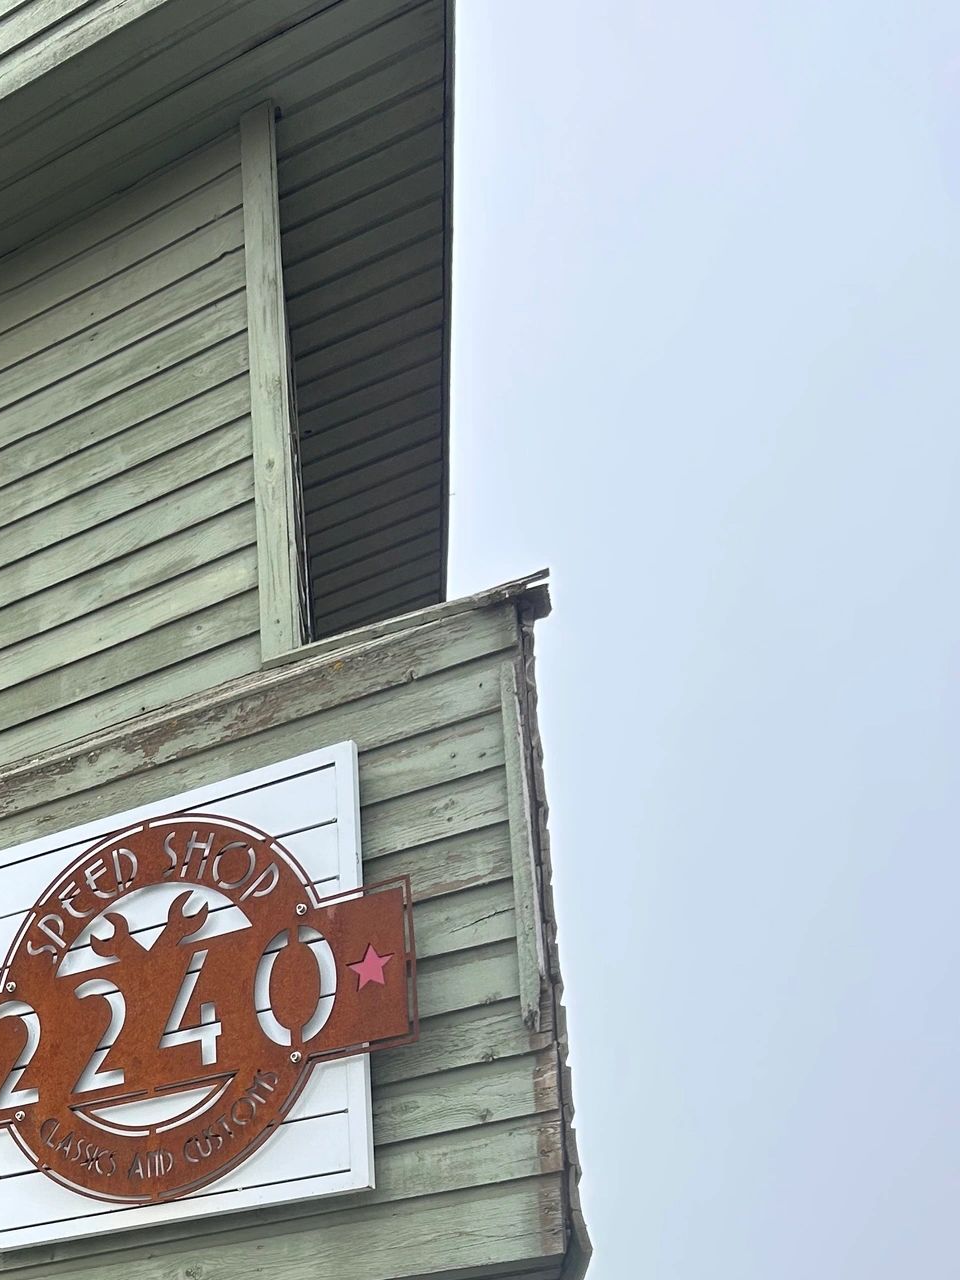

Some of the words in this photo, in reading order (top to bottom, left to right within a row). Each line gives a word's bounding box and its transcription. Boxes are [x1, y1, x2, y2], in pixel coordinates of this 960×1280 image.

[27, 848, 138, 965] SPEED
[163, 831, 280, 902] SHOP
[40, 1117, 117, 1177] CLASSICS
[127, 1149, 174, 1179] AND
[183, 1068, 279, 1163] CUSTOMS
